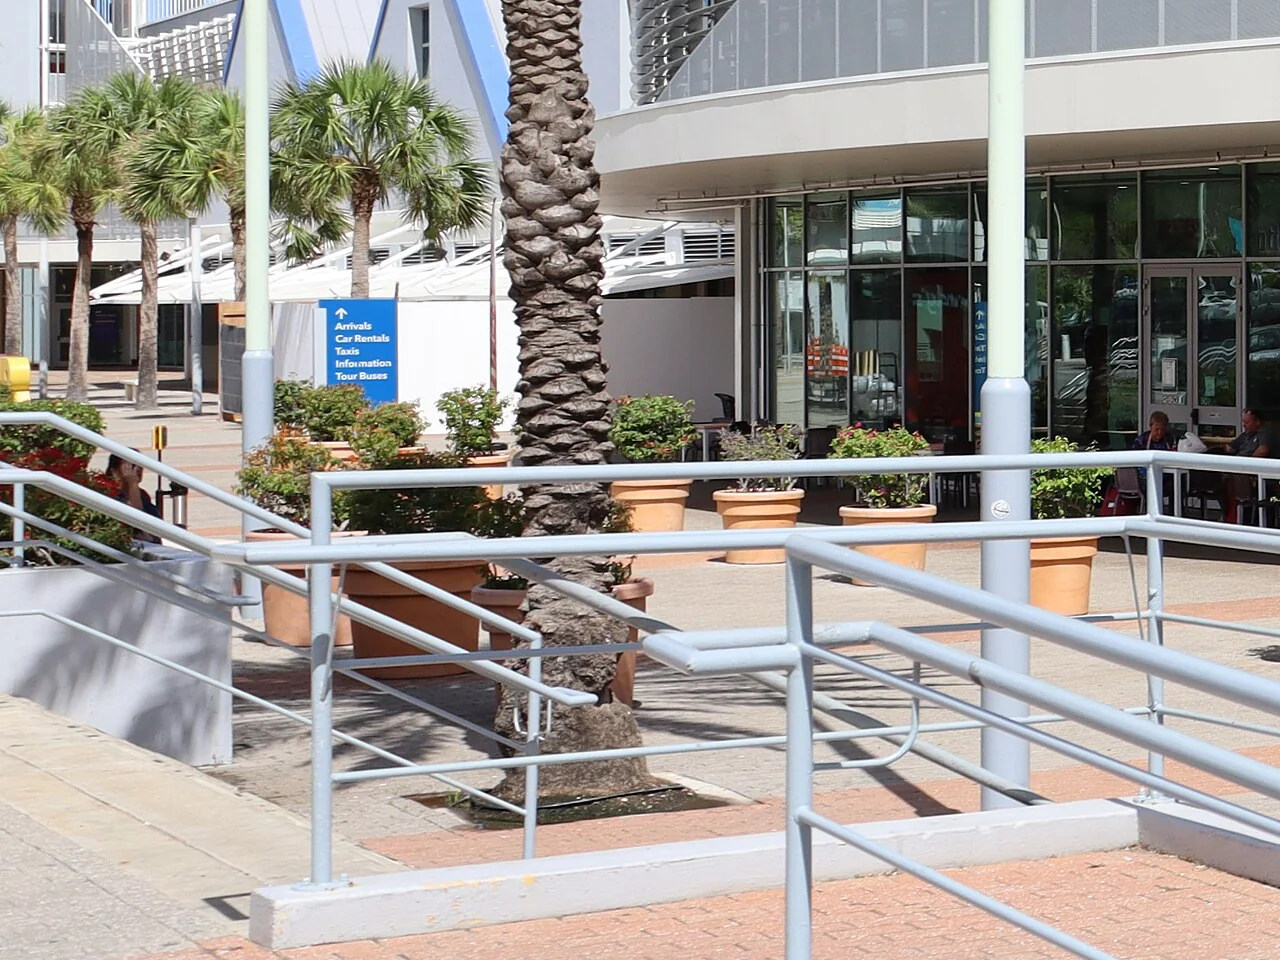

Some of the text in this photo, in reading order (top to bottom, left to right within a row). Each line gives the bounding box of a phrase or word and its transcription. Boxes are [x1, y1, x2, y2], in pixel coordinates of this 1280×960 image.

[334, 322, 372, 330] Arrivals
[335, 334, 390, 343] Car Rentals
[334, 347, 360, 355] Taxis
[335, 359, 392, 368] Information
[335, 371, 388, 380] Tour Buses
